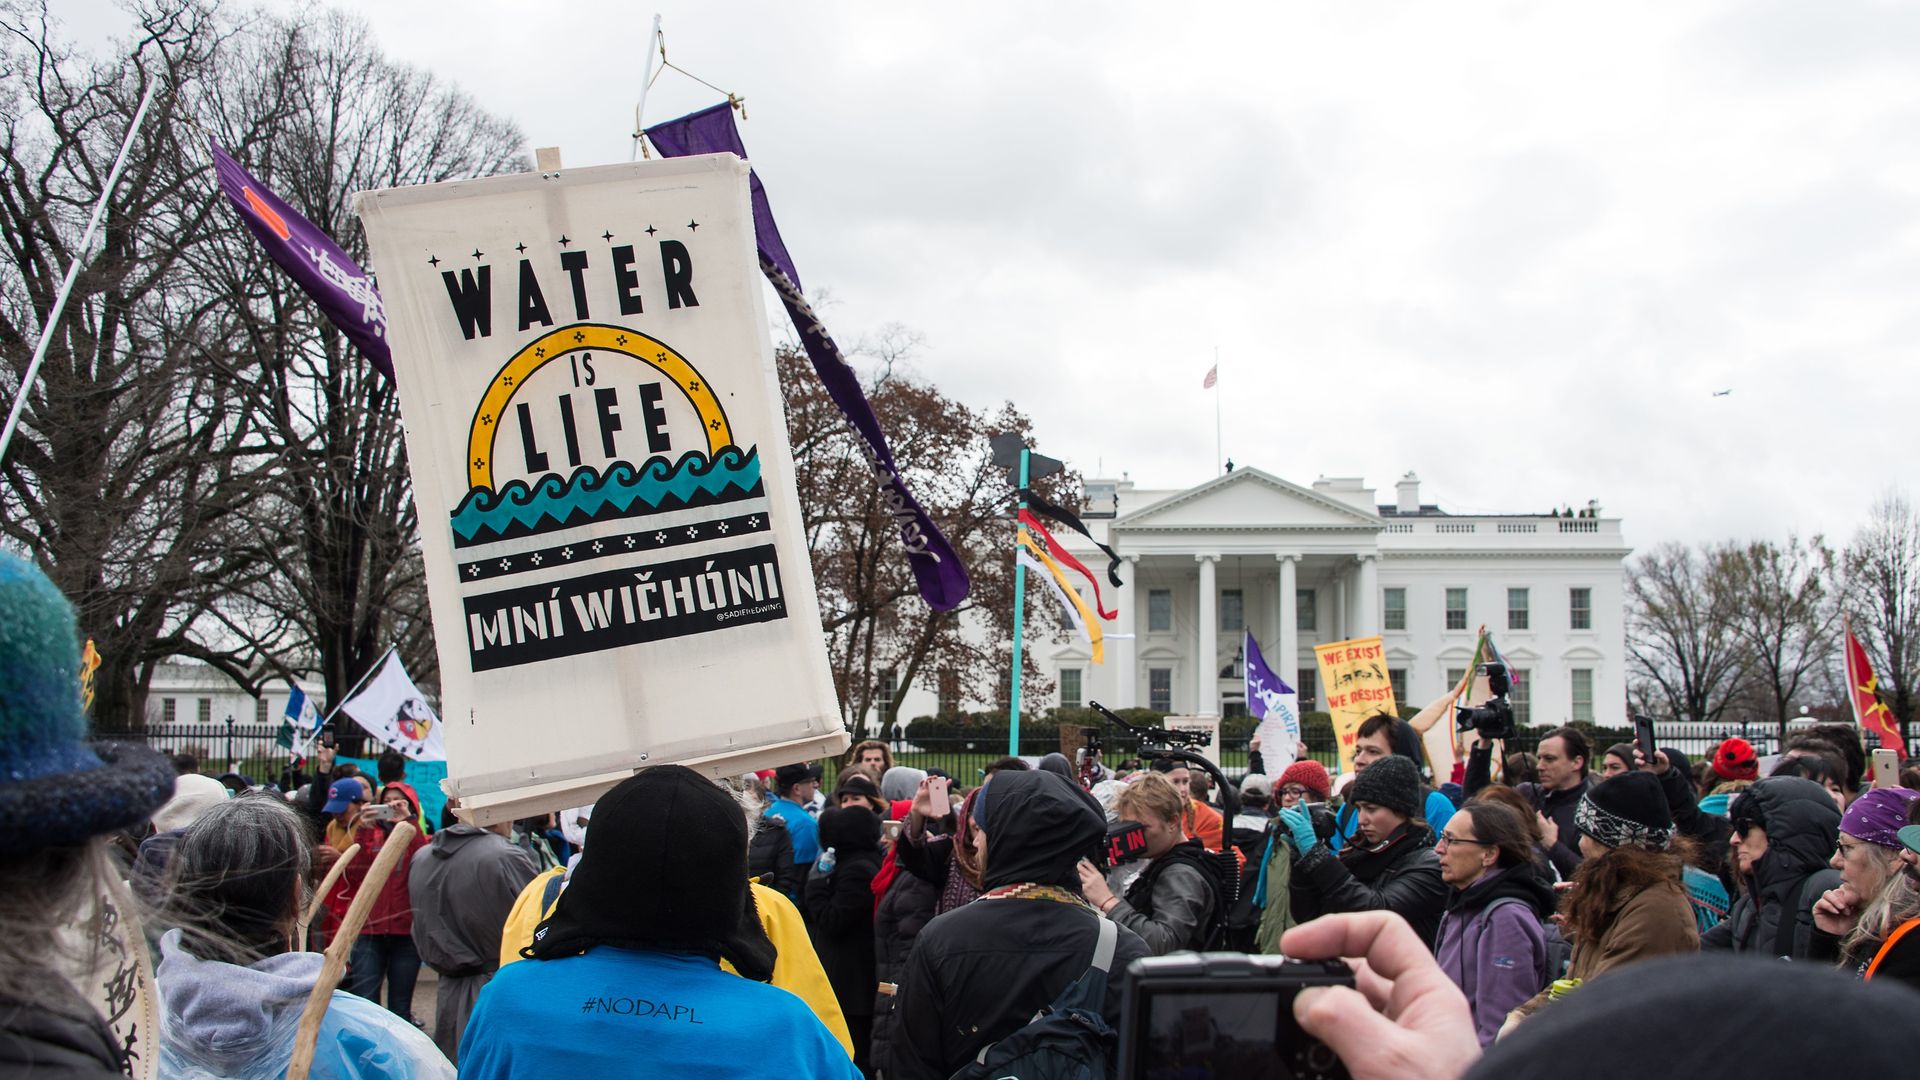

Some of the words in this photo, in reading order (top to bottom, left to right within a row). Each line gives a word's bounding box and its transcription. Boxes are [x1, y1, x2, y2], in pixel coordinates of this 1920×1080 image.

[442, 240, 700, 340] WATER
[570, 352, 596, 388] IS
[517, 382, 671, 474] LIFE
[470, 587, 564, 651] MNÍ
[570, 560, 779, 633] WIČHÓNI
[716, 603, 782, 622] @SADIEREDWING
[1323, 652, 1344, 666] WE
[1346, 644, 1381, 662] EXIST
[1328, 695, 1349, 709] WE
[1350, 687, 1392, 704] RESIST
[581, 996, 704, 1025] #NODAPL
